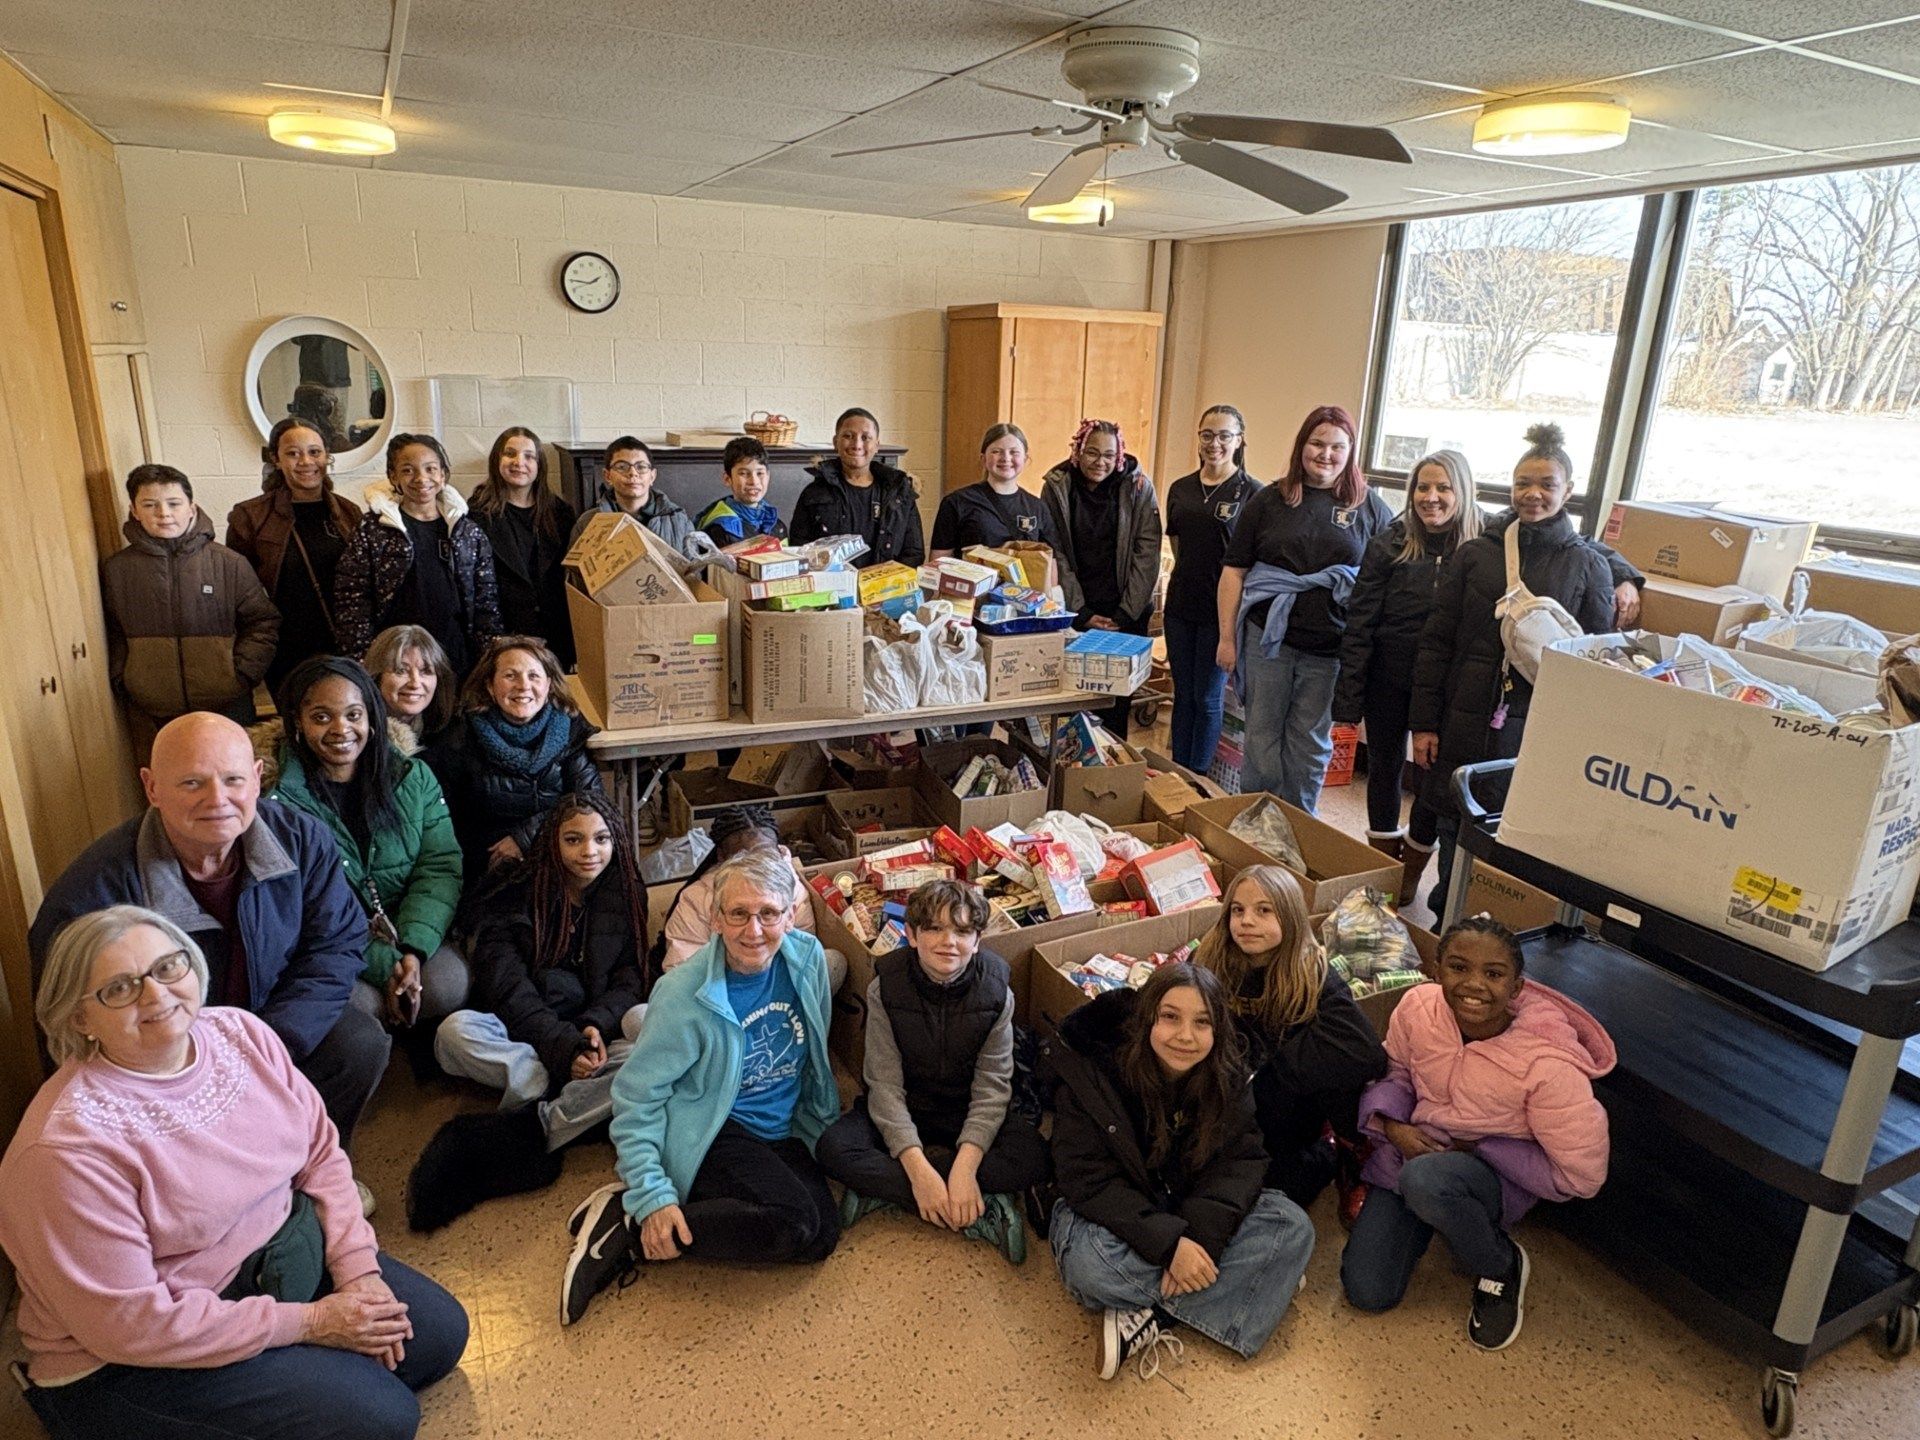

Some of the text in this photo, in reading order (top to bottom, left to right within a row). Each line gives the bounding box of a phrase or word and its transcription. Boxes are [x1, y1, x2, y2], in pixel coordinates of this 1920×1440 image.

[1076, 678, 1114, 692] JIFFY
[1475, 873, 1527, 901] CULINARY
[769, 1002, 790, 1012] OUT
[1477, 1277, 1505, 1296] NIKE
